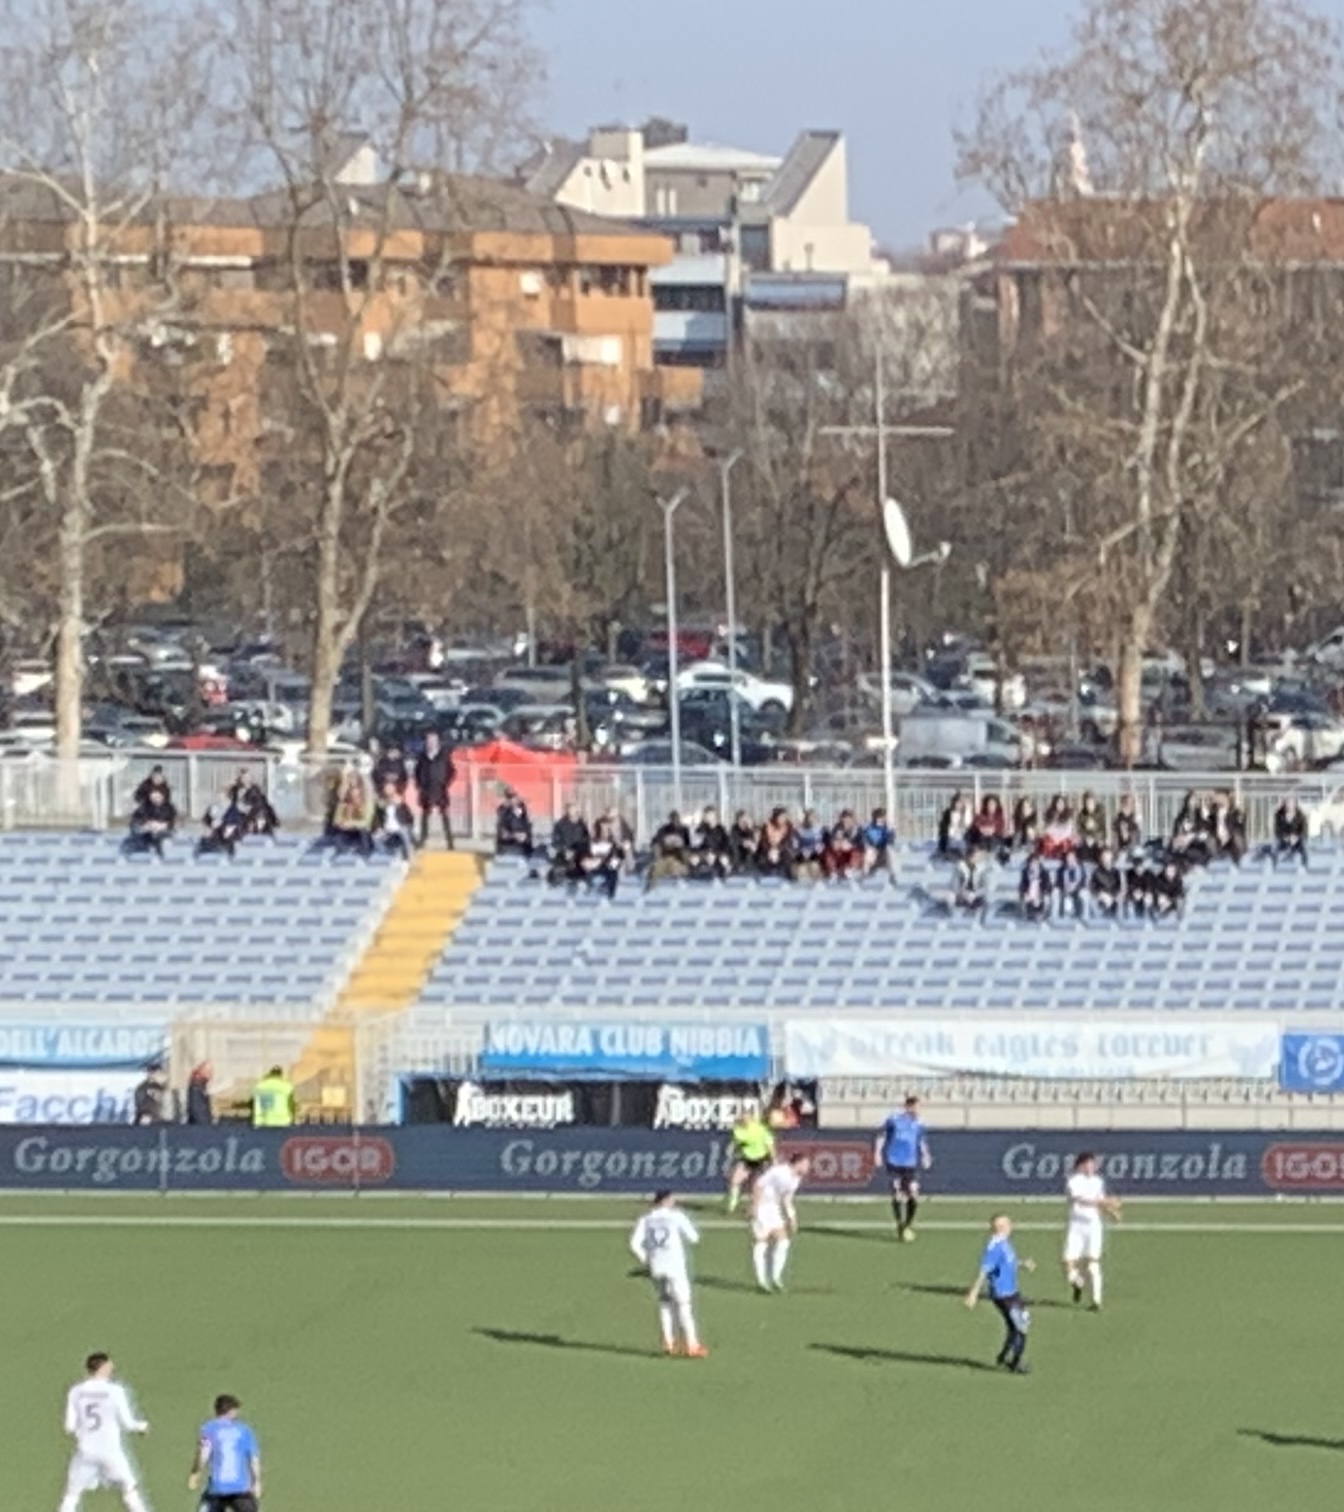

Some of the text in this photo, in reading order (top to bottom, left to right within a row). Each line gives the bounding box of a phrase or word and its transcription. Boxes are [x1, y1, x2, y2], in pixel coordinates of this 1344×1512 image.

[488, 1024, 592, 1056] NOVARA
[601, 1025, 663, 1055] CLUB
[14, 1135, 381, 1182] Gorgonzola IGOR
[84, 1403, 101, 1431] 5
